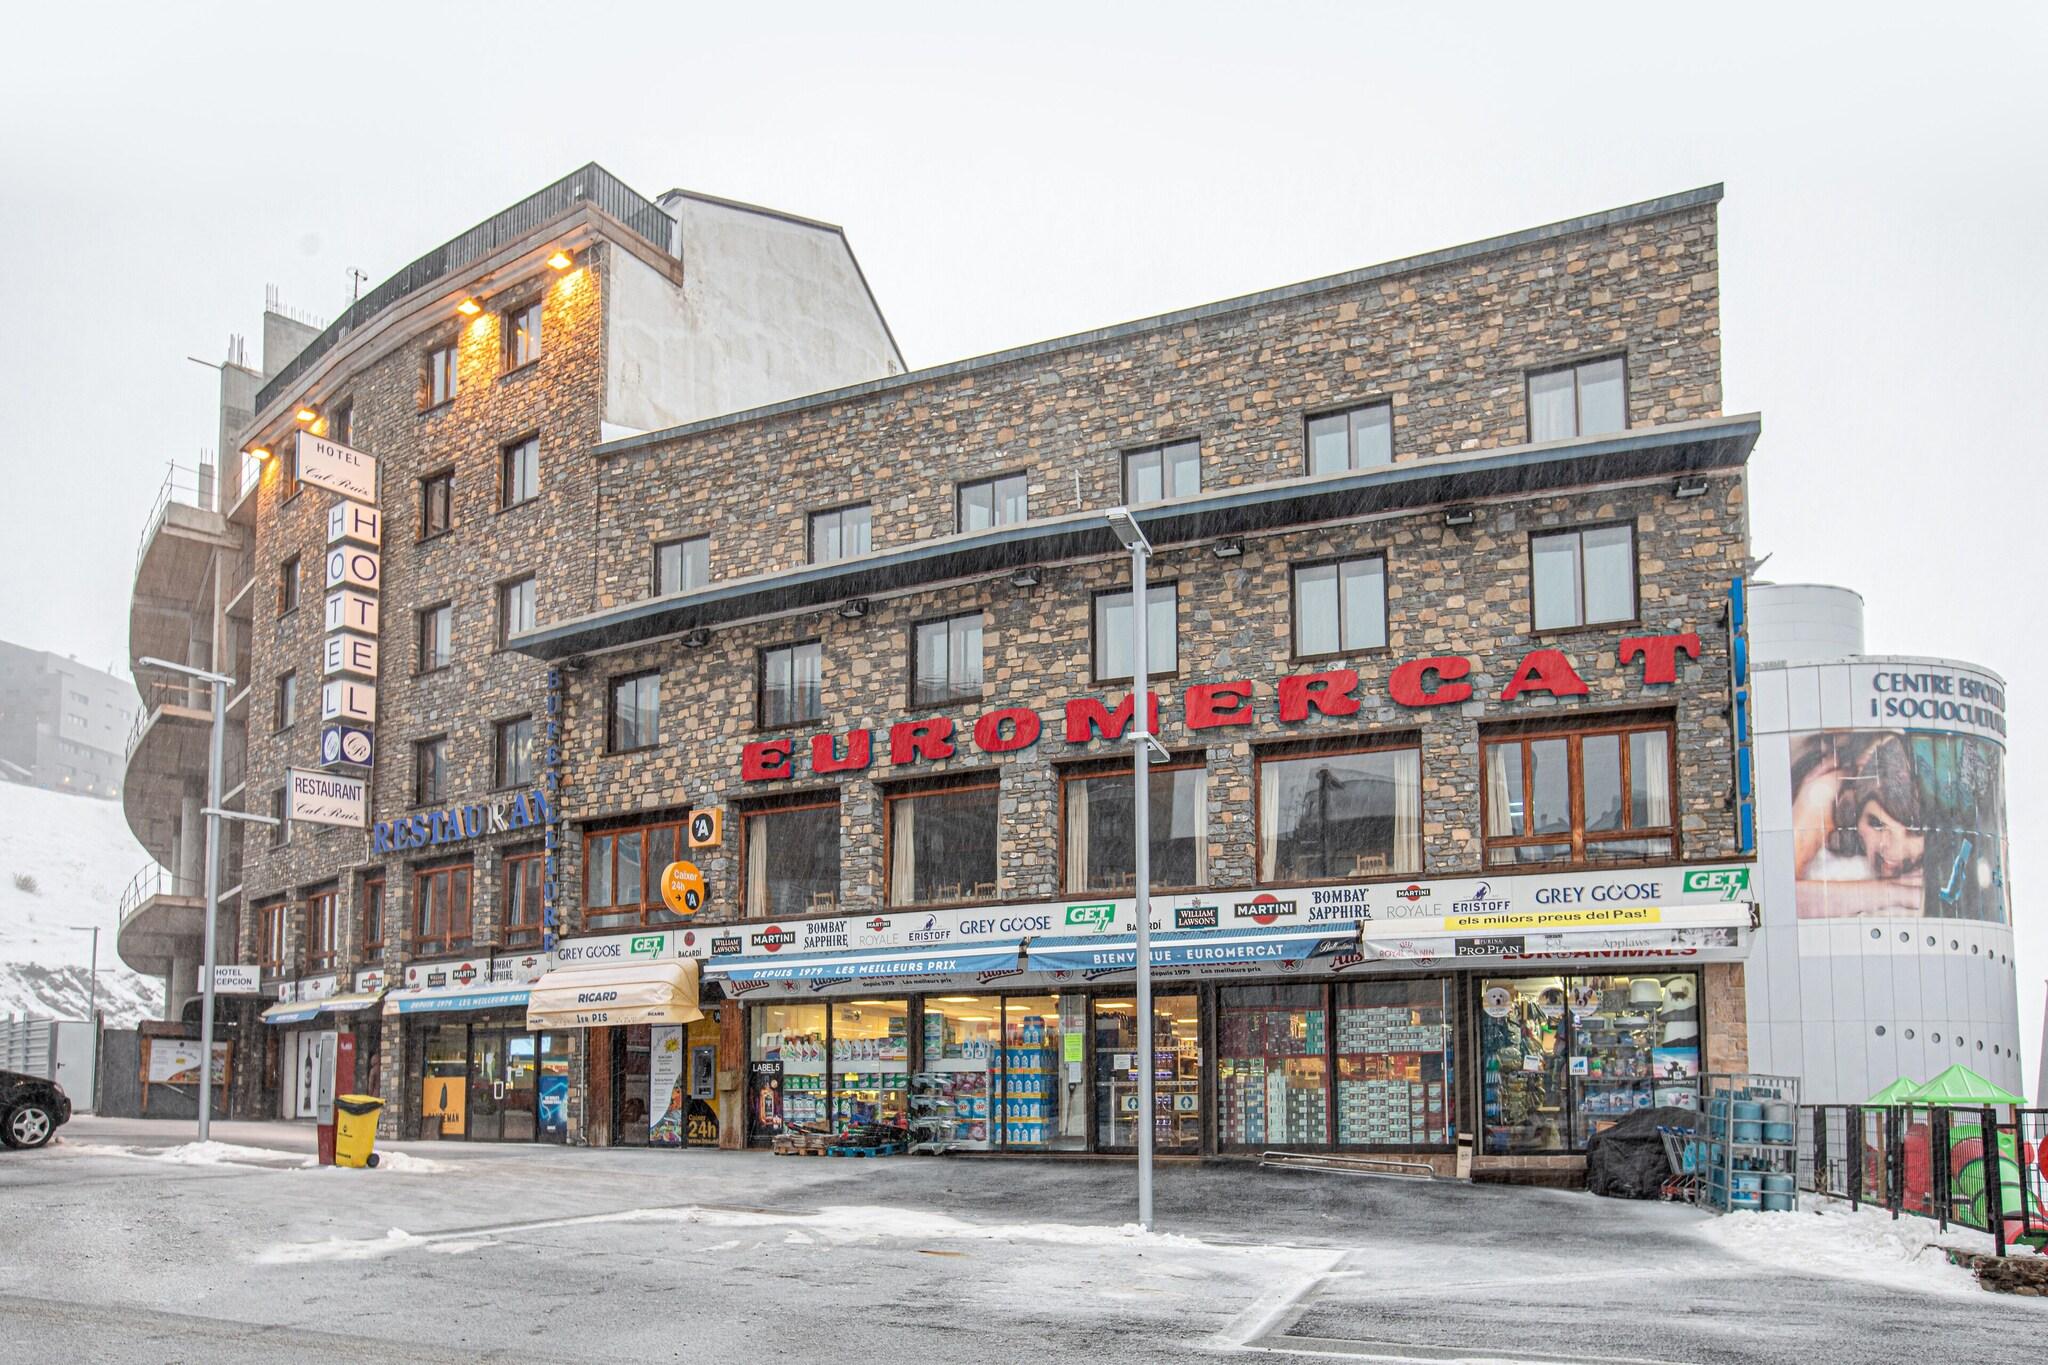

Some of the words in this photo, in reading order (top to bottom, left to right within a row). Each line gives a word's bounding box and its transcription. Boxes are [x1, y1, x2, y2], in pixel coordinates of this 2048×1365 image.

[316, 442, 361, 467] HOTEL
[325, 506, 345, 714] HOTEL
[349, 508, 378, 715] HOTEL
[1872, 672, 1954, 695] CENTRE
[741, 632, 1701, 782] EUROMERCAT
[1871, 698, 1878, 717] I
[294, 776, 363, 802] RESTAURANT
[673, 869, 698, 881] Caixer
[1689, 870, 1742, 889] GET
[671, 880, 686, 891] 24h
[1535, 886, 1585, 904] GREY
[1591, 881, 1661, 901] GOOSE
[1722, 884, 1741, 901] 27
[1311, 889, 1368, 904] BOMBAY
[1398, 889, 1430, 898] MARTINI
[1069, 906, 1111, 922] GET
[1180, 910, 1214, 918] WILLIAM
[1237, 903, 1293, 915] MARTINI
[1308, 904, 1371, 922] SAPPHIRE
[1386, 903, 1442, 919] ROYALE
[1452, 900, 1511, 913] ERISTOFF
[866, 920, 891, 929] MARTINI
[1178, 917, 1216, 926] LAWSON'S
[1458, 916, 1480, 926] els
[1483, 914, 1533, 924] millors
[1538, 911, 1581, 925] preus
[1586, 909, 1609, 920] del
[1614, 908, 1648, 919] Pas!
[806, 921, 848, 935] BOMBAY
[959, 919, 995, 935] GREY
[999, 915, 1051, 932] GOOSE
[1092, 918, 1109, 933] 27
[633, 936, 661, 951] GET
[753, 931, 794, 944] MARTINI
[803, 934, 849, 950] SAPPHIRE
[859, 932, 899, 946] ROYALE
[908, 930, 951, 942] ERISTOFF
[1601, 936, 1651, 949] Applaws
[558, 947, 582, 960] GREY
[586, 944, 621, 958] GOOSE
[713, 945, 740, 953] LAWSON'S
[1093, 950, 1172, 965] BIENVUE
[1187, 944, 1284, 960] EUROMERCAT
[1458, 945, 1485, 956] PRO
[1487, 944, 1521, 954] PLAN
[753, 969, 793, 979] DEPUIS
[799, 967, 823, 977] 1979
[835, 965, 855, 975] LES
[859, 962, 924, 974] MEILLEURS
[927, 960, 956, 971] PRIX
[1151, 969, 1173, 977] depuis
[1174, 968, 1190, 976] 1979
[1247, 966, 1261, 975] prix
[577, 991, 618, 1004] RICARD
[592, 1012, 608, 1023] PIS
[687, 1120, 717, 1138] 24h
